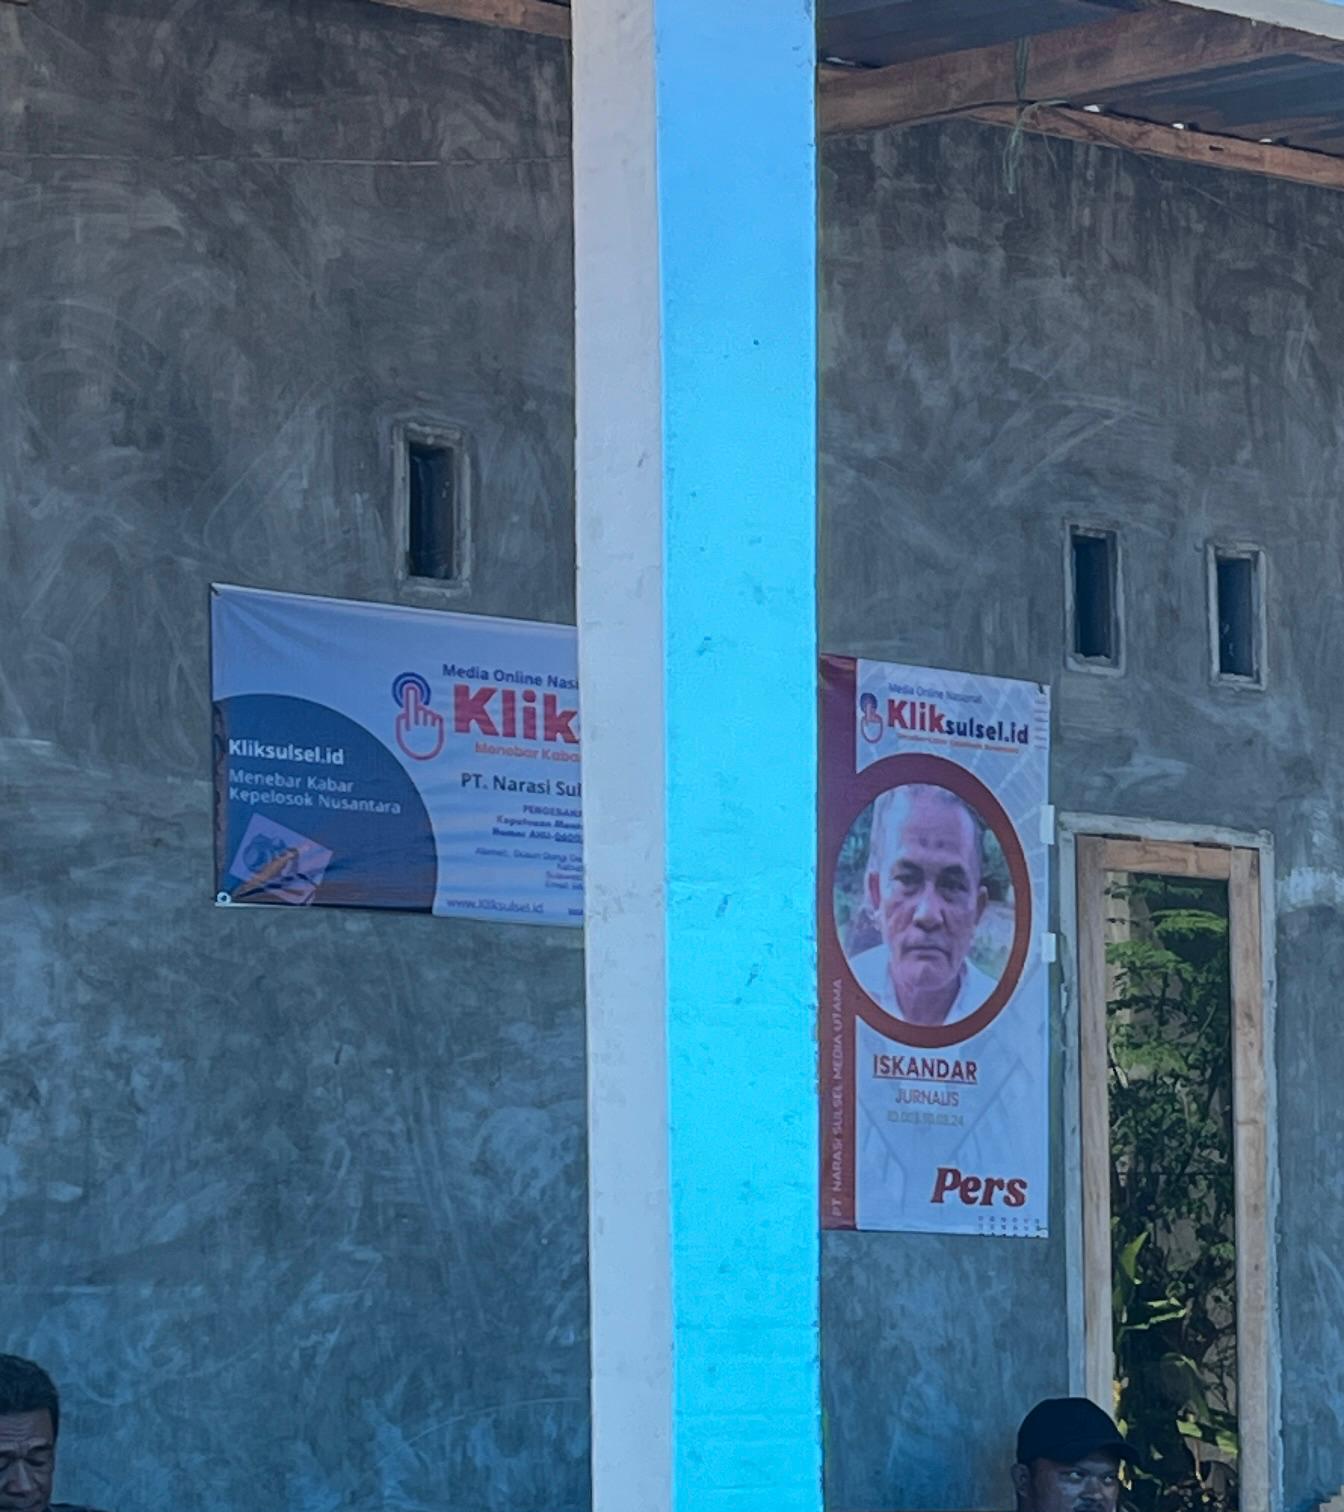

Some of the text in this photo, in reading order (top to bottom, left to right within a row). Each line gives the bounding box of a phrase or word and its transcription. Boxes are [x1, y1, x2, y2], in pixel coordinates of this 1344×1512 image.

[442, 664, 489, 680] Media
[493, 669, 542, 686] Online
[454, 683, 579, 744] Klik
[887, 699, 1029, 744] Kliksulsel.id
[229, 738, 344, 765] Kliksulsel.id
[229, 768, 354, 793] Menebar Kabar
[461, 772, 488, 789] PT.
[493, 775, 551, 795] Narasi
[229, 786, 401, 815] Kepelosok Nusantara
[831, 978, 843, 1032] UTAMA
[831, 1034, 843, 1080] MEDIA
[873, 1054, 977, 1081] ISKANDAR
[930, 1167, 1028, 1208] Pers
